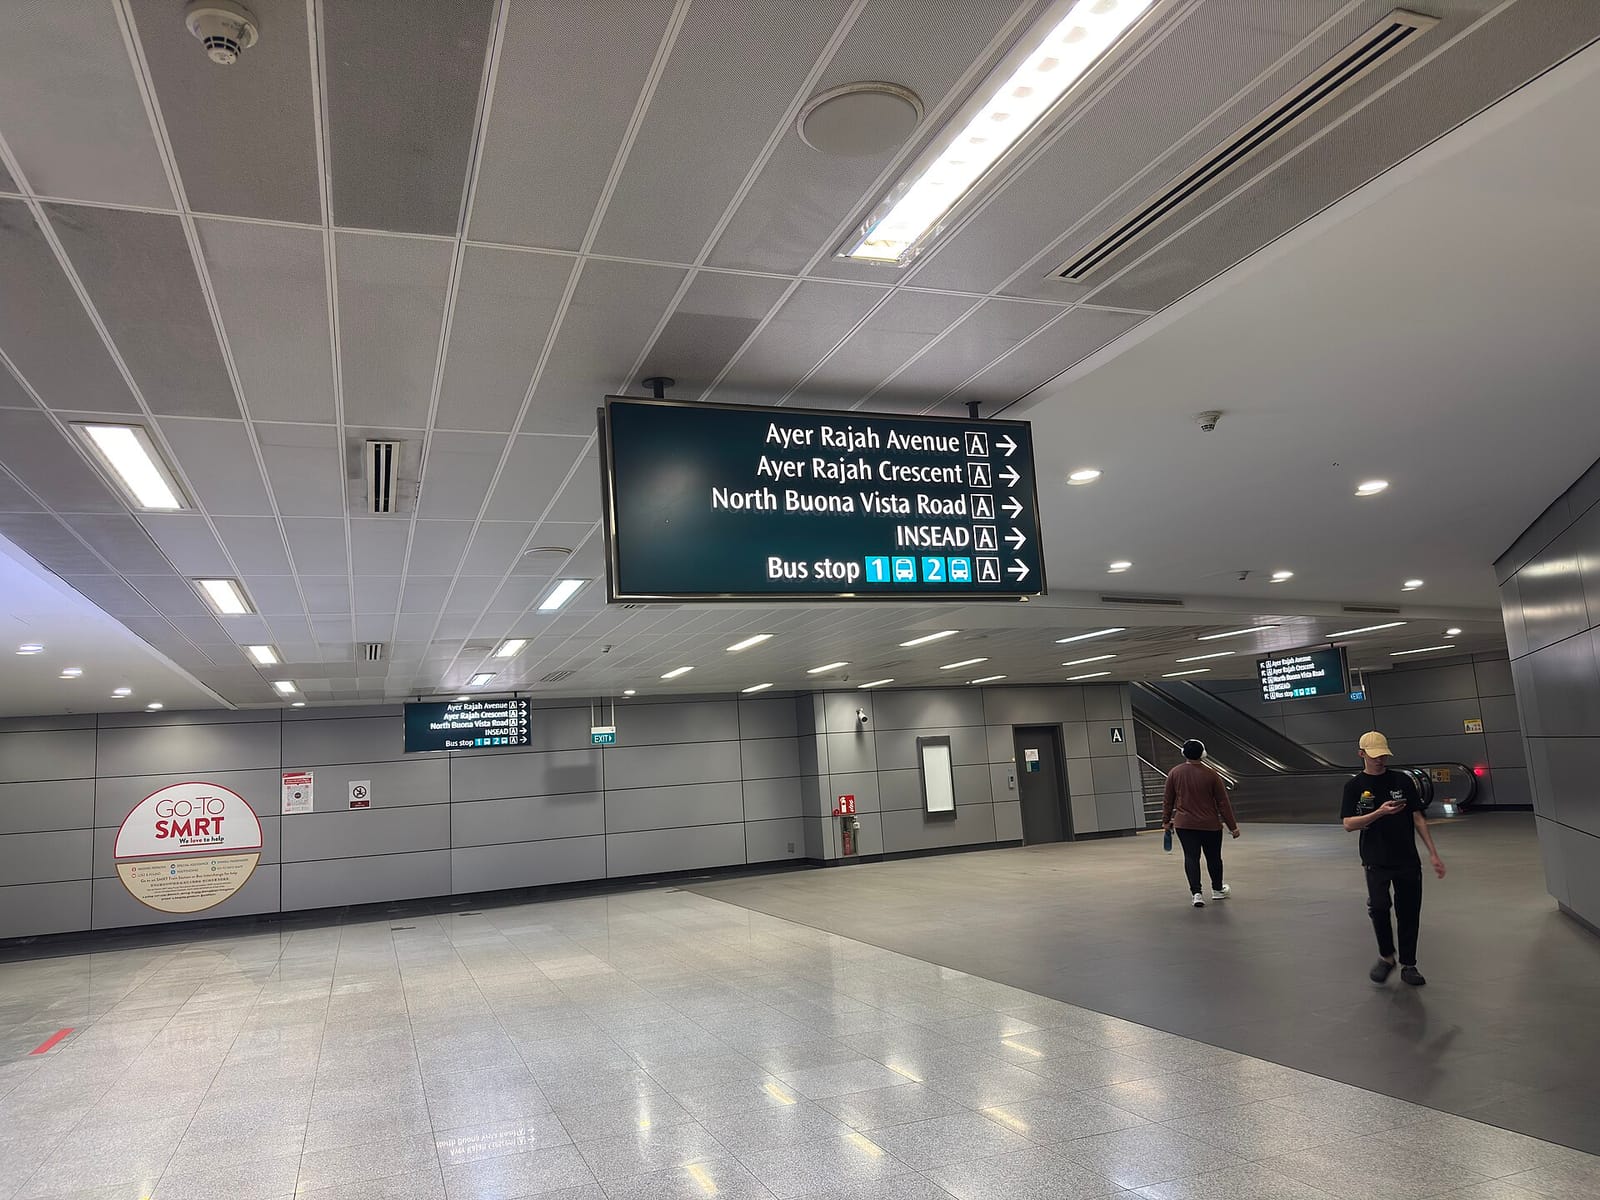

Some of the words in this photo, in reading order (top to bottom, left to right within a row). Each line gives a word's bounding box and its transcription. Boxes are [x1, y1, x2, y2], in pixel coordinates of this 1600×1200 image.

[766, 423, 814, 449] Ayer
[821, 426, 880, 451] Rajah
[887, 430, 960, 452] Avenue
[970, 434, 986, 454] A
[757, 456, 805, 481] Ayer
[812, 458, 872, 484] Rajah
[879, 461, 963, 483] Crescent
[972, 465, 988, 485] A
[712, 487, 777, 510] North
[785, 489, 854, 512] Buona
[860, 492, 910, 514] Vista
[918, 494, 967, 515] Road
[976, 497, 991, 517] A
[897, 525, 970, 547] INSEAD
[979, 529, 994, 549] A
[768, 556, 808, 579] Bus
[814, 558, 860, 583] stop
[927, 559, 942, 581] 2
[982, 560, 997, 580] A
[443, 713, 459, 721] Ayer
[460, 711, 480, 720] Rajah
[481, 711, 508, 719] Crescent
[447, 704, 463, 712] Ayer
[464, 703, 482, 711] Rajah
[430, 722, 450, 730] North
[451, 721, 473, 729] Buona
[485, 728, 508, 736] INSEAD
[459, 739, 474, 747] stop
[595, 735, 608, 743] EXIT
[1113, 729, 1122, 742] A
[156, 797, 225, 818] GO-TO
[155, 816, 225, 839] SMRT
